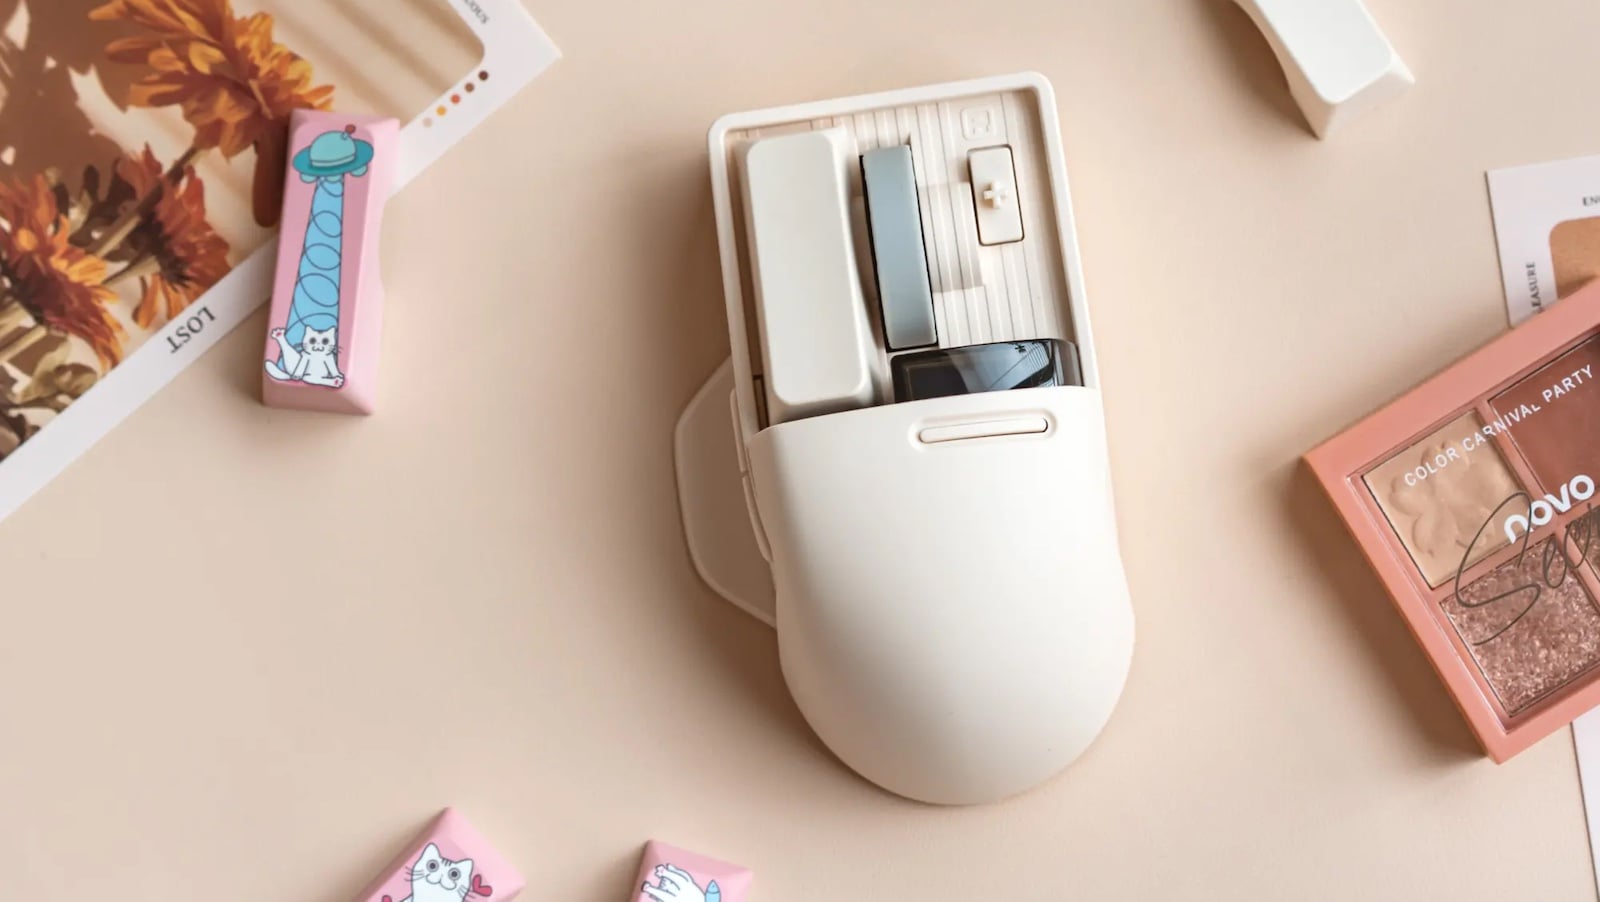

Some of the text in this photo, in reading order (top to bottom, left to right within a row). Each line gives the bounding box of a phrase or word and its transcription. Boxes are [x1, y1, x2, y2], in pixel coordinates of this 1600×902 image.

[166, 306, 216, 354] LOST
[1404, 364, 1594, 487] COLOR CARNIVAL PARTY
